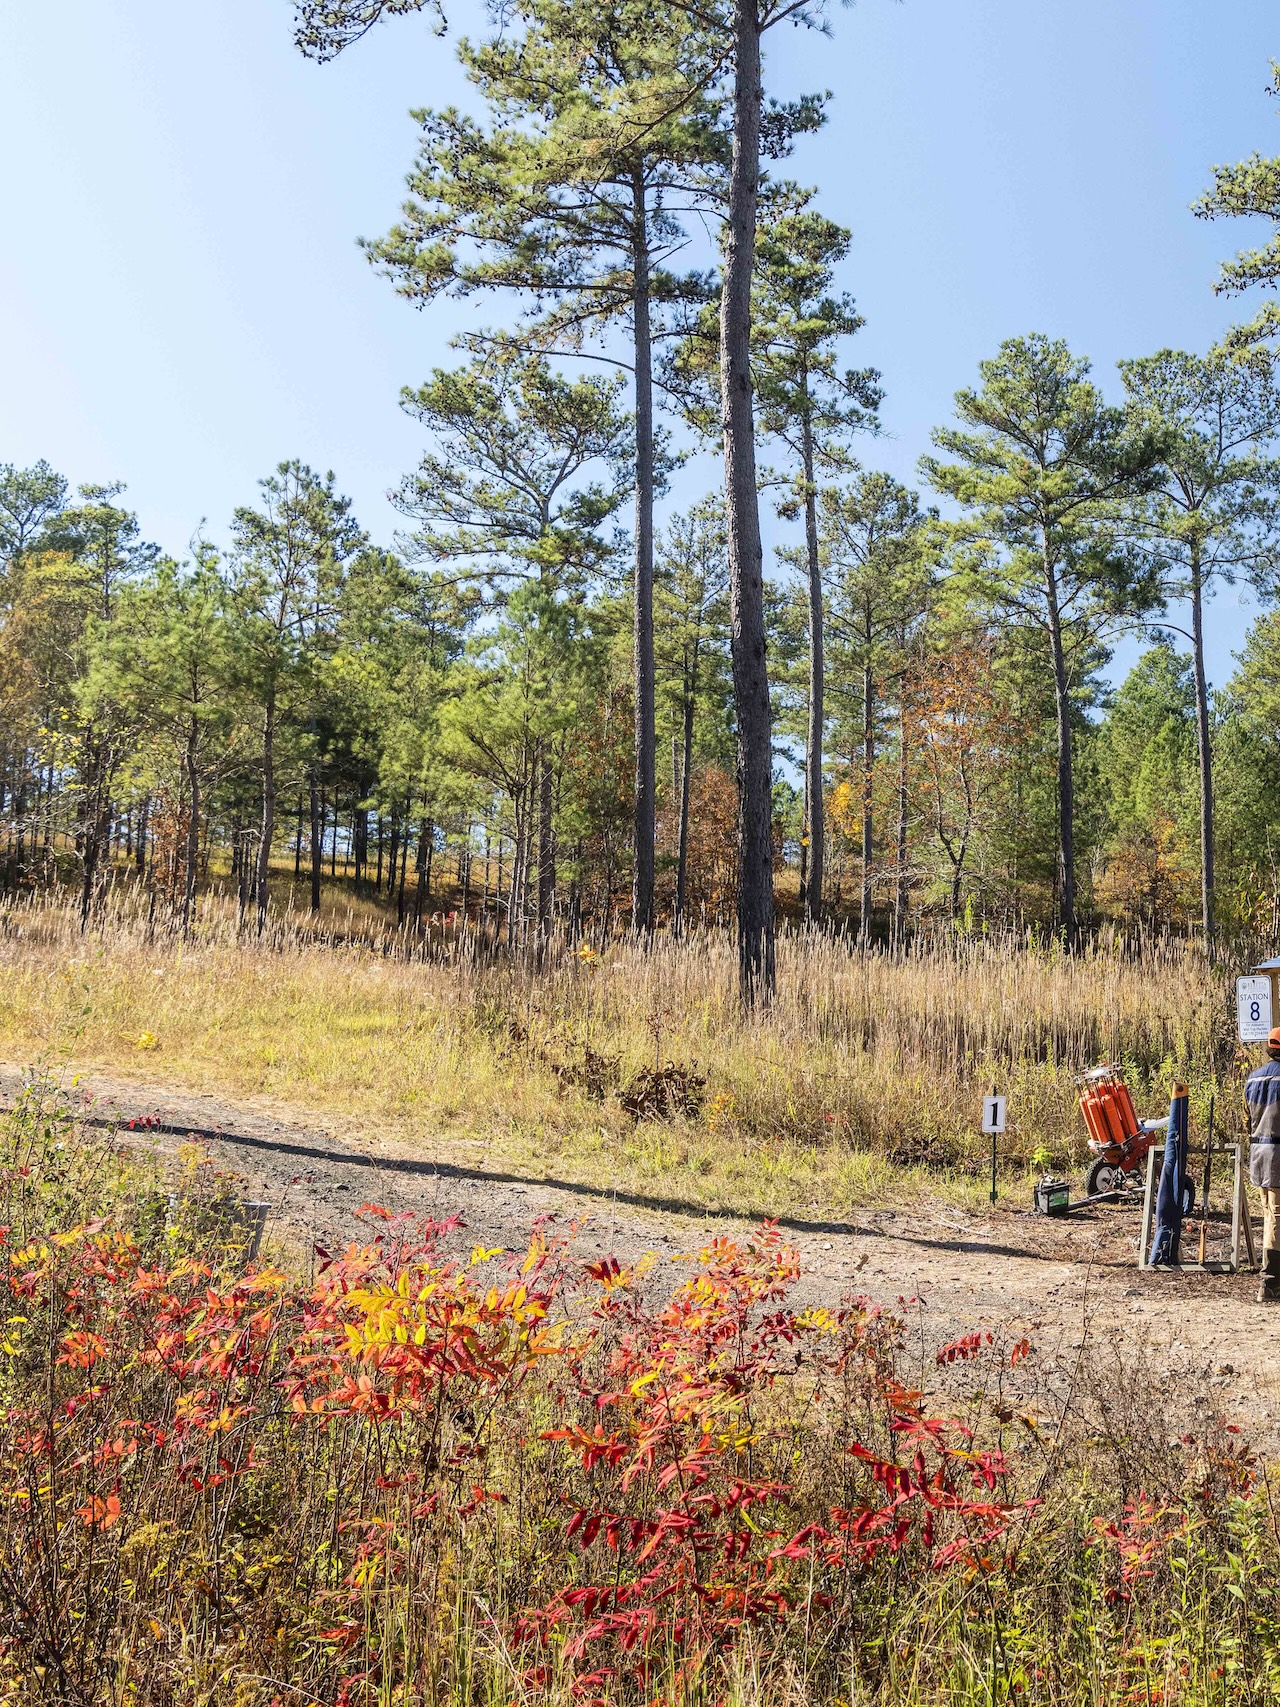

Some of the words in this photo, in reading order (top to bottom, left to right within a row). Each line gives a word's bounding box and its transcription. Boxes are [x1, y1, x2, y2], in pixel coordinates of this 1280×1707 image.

[1240, 993, 1269, 1001] STATION
[1250, 1002, 1260, 1021] 8
[988, 1102, 1000, 1126] 1
